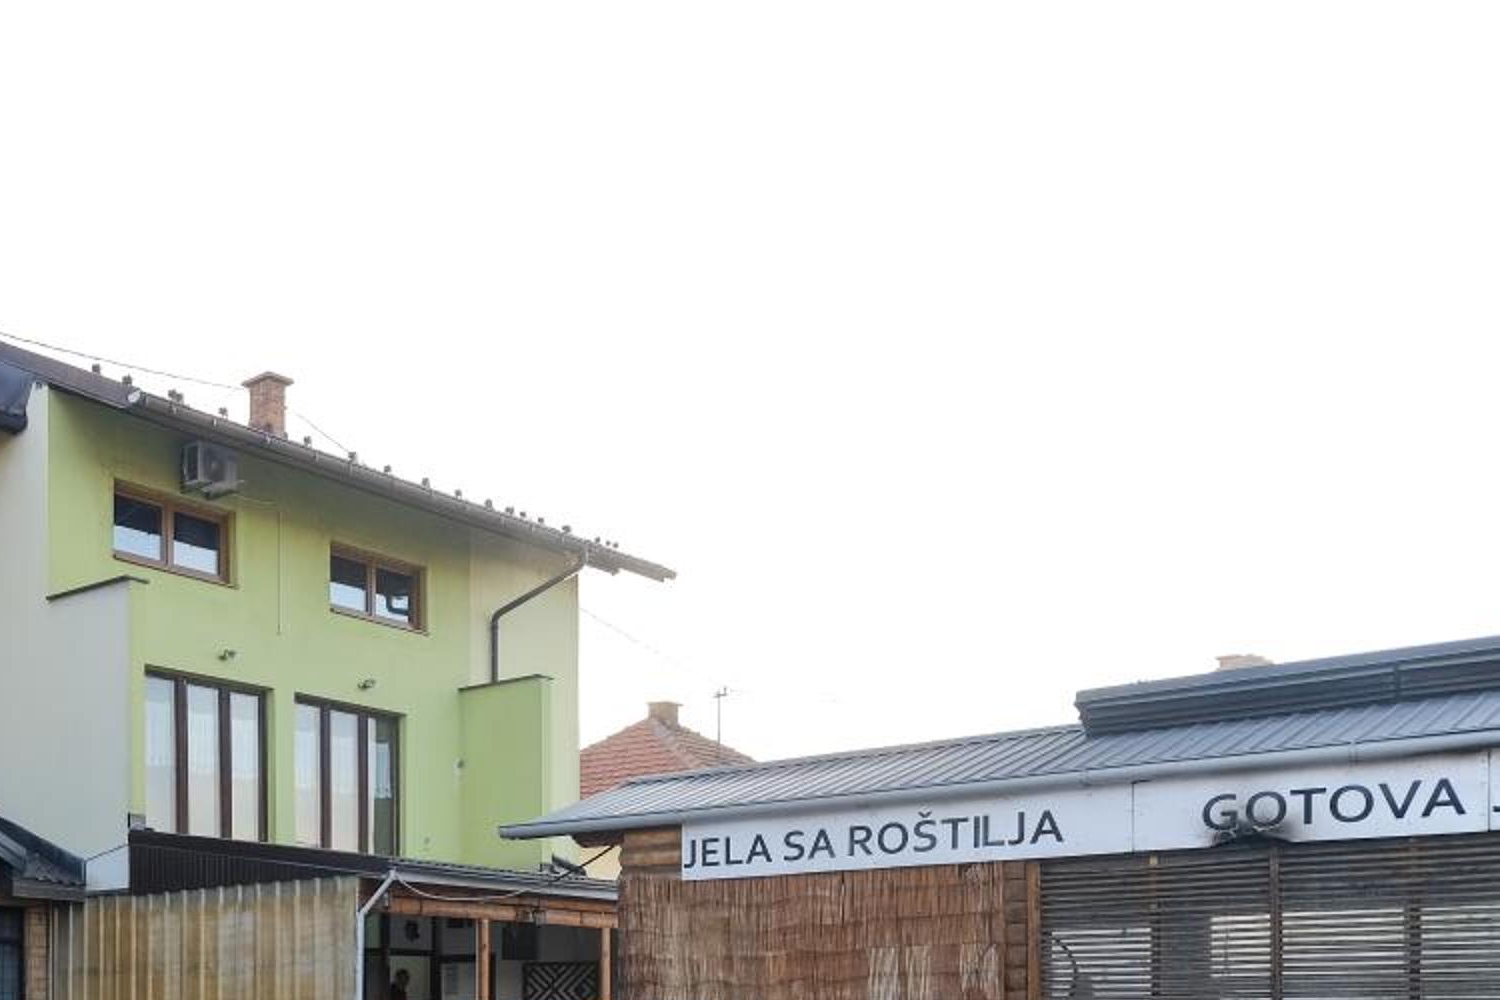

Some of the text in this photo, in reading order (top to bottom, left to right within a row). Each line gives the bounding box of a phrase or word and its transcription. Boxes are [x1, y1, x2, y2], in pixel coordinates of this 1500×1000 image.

[1202, 777, 1466, 831] GOTOVA
[683, 809, 1064, 869] JELA SA ROŠTILJA
